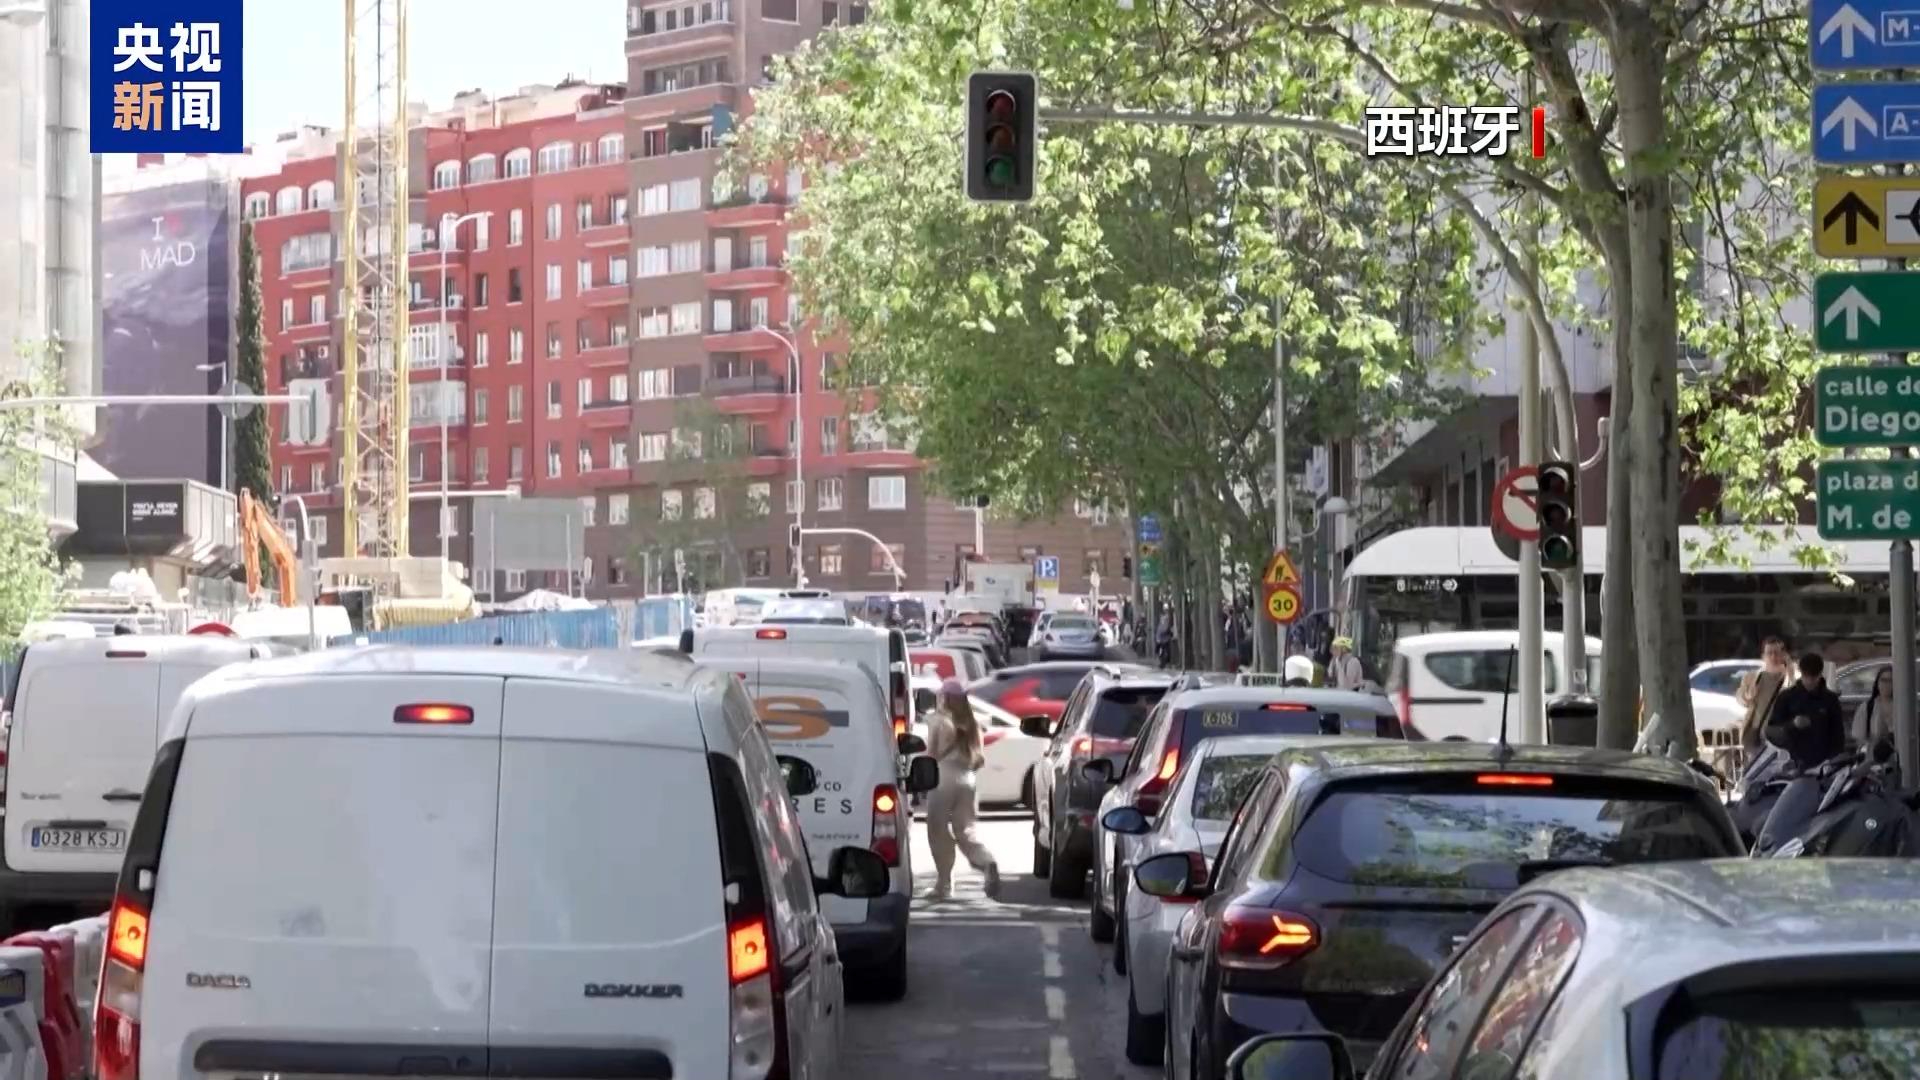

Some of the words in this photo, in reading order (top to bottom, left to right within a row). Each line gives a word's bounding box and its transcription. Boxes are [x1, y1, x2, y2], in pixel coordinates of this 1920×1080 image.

[152, 216, 165, 242] I
[140, 241, 196, 271] MAD
[1825, 375, 1889, 396] calle
[1825, 405, 1920, 438] Diego
[1826, 471, 1894, 495] plaza
[1827, 504, 1863, 530] M.
[1872, 504, 1912, 530] de
[1041, 558, 1055, 577] P
[1273, 599, 1294, 612] 30
[41, 831, 82, 847] 0328
[87, 831, 120, 848] KSJ
[584, 983, 683, 998] DOKKER
